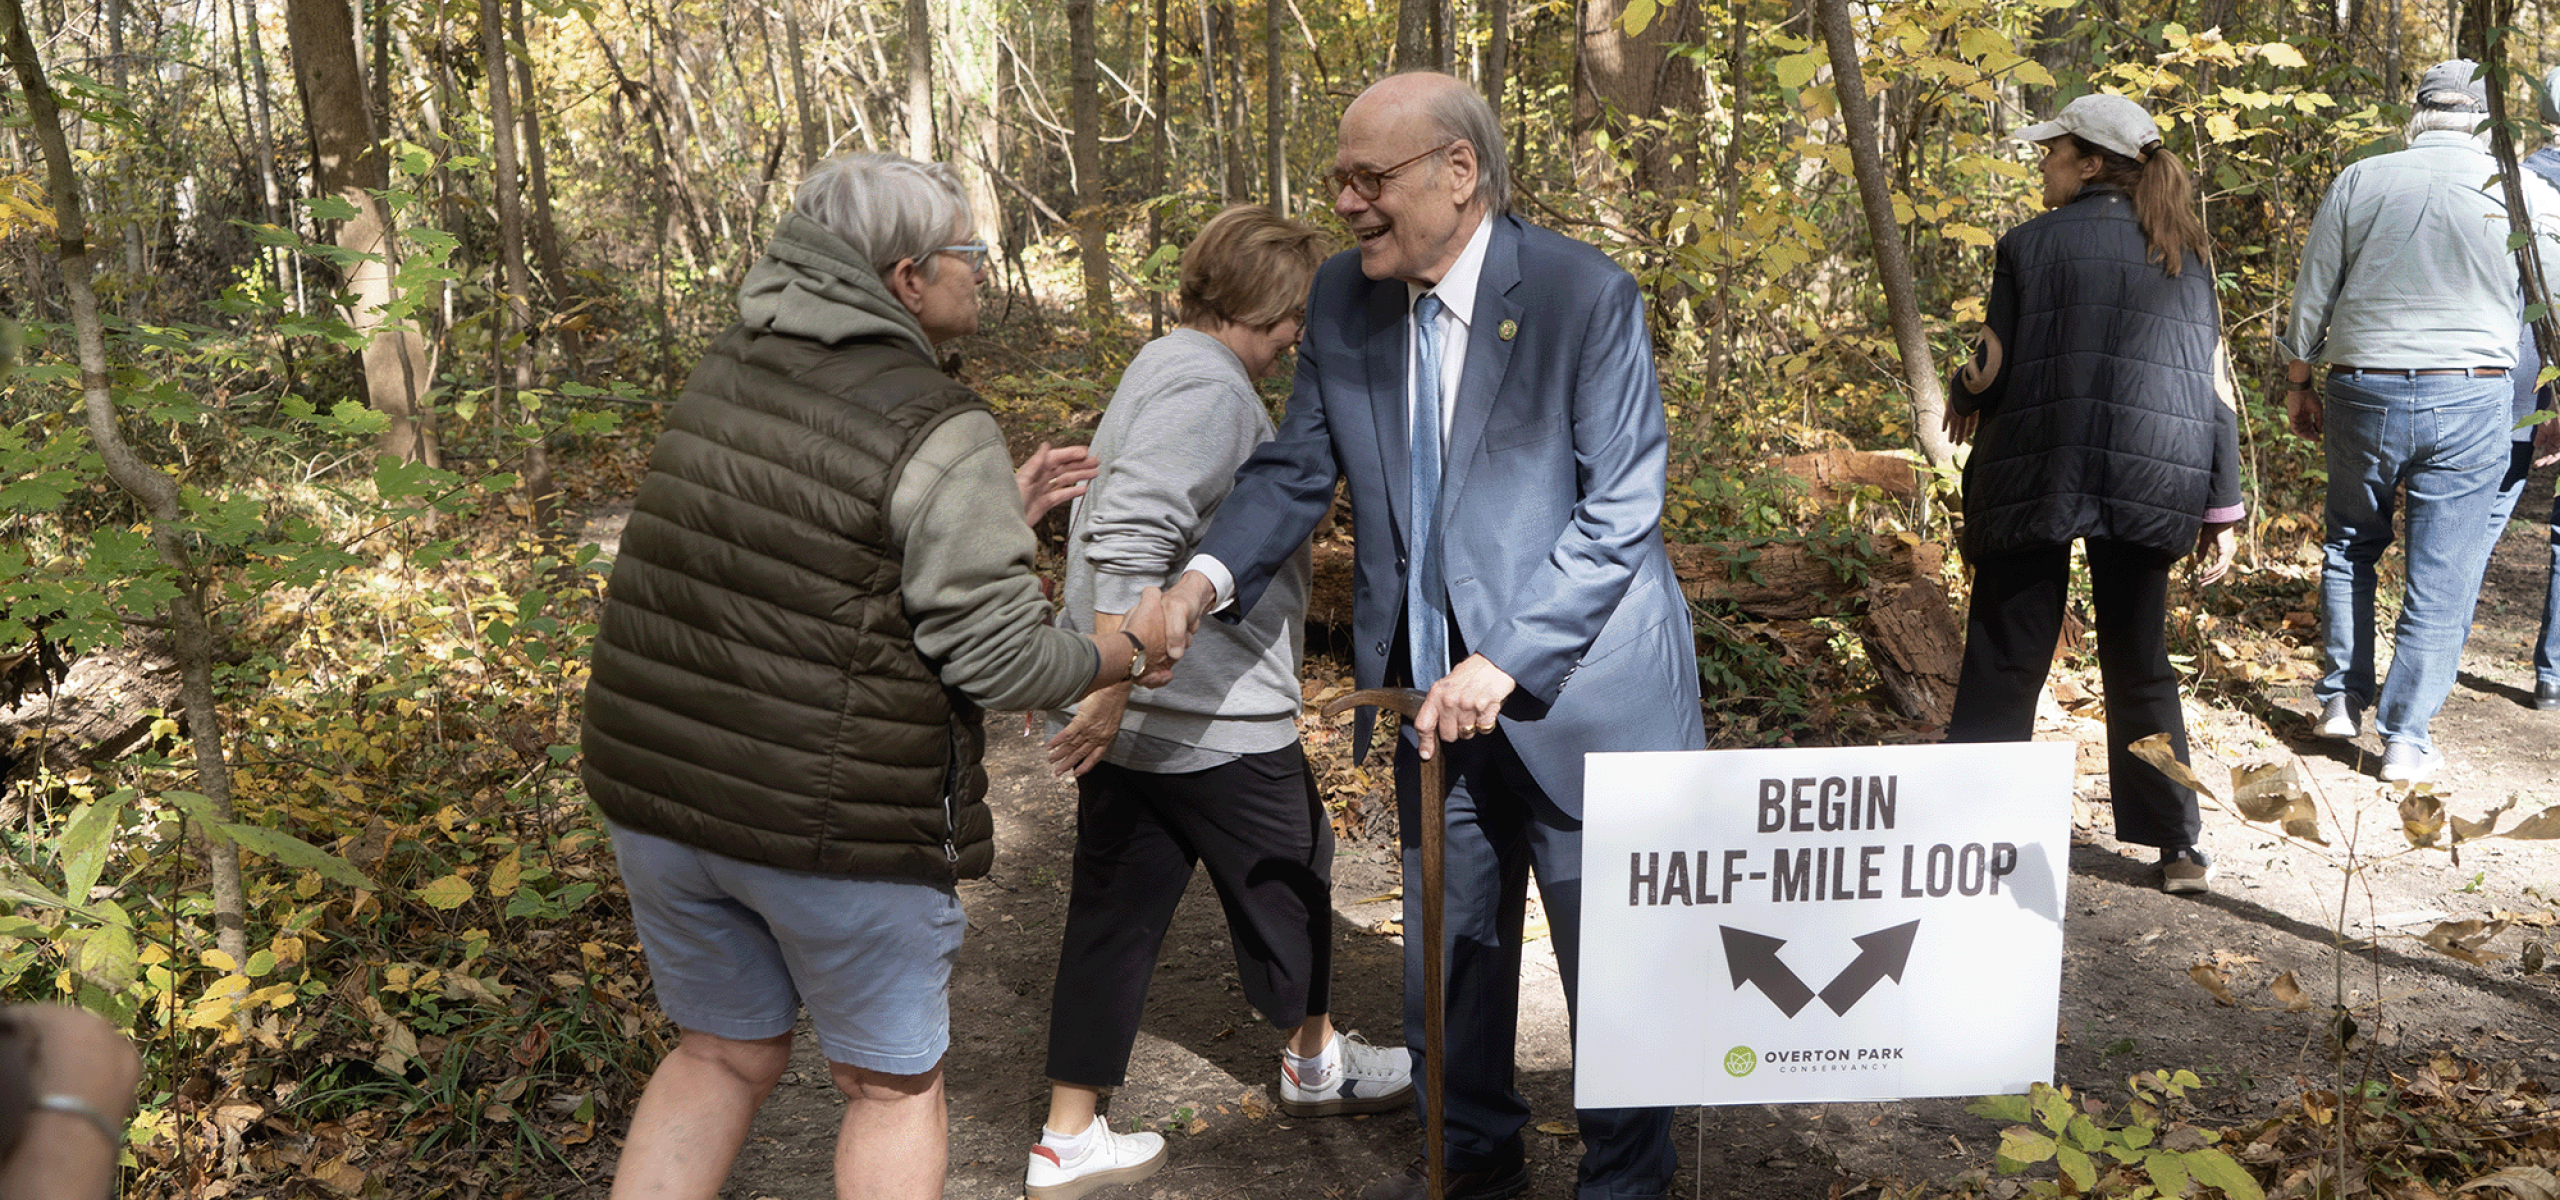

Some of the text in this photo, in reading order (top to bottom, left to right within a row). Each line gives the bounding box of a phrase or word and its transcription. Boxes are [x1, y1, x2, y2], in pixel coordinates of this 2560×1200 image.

[1757, 775, 1898, 833] BEGIN
[1628, 842, 2018, 906] HALF-MILE LOOP
[1764, 1047, 1904, 1063] OVERTON PARK
[1779, 1063, 1889, 1073] CONSERVANCY
